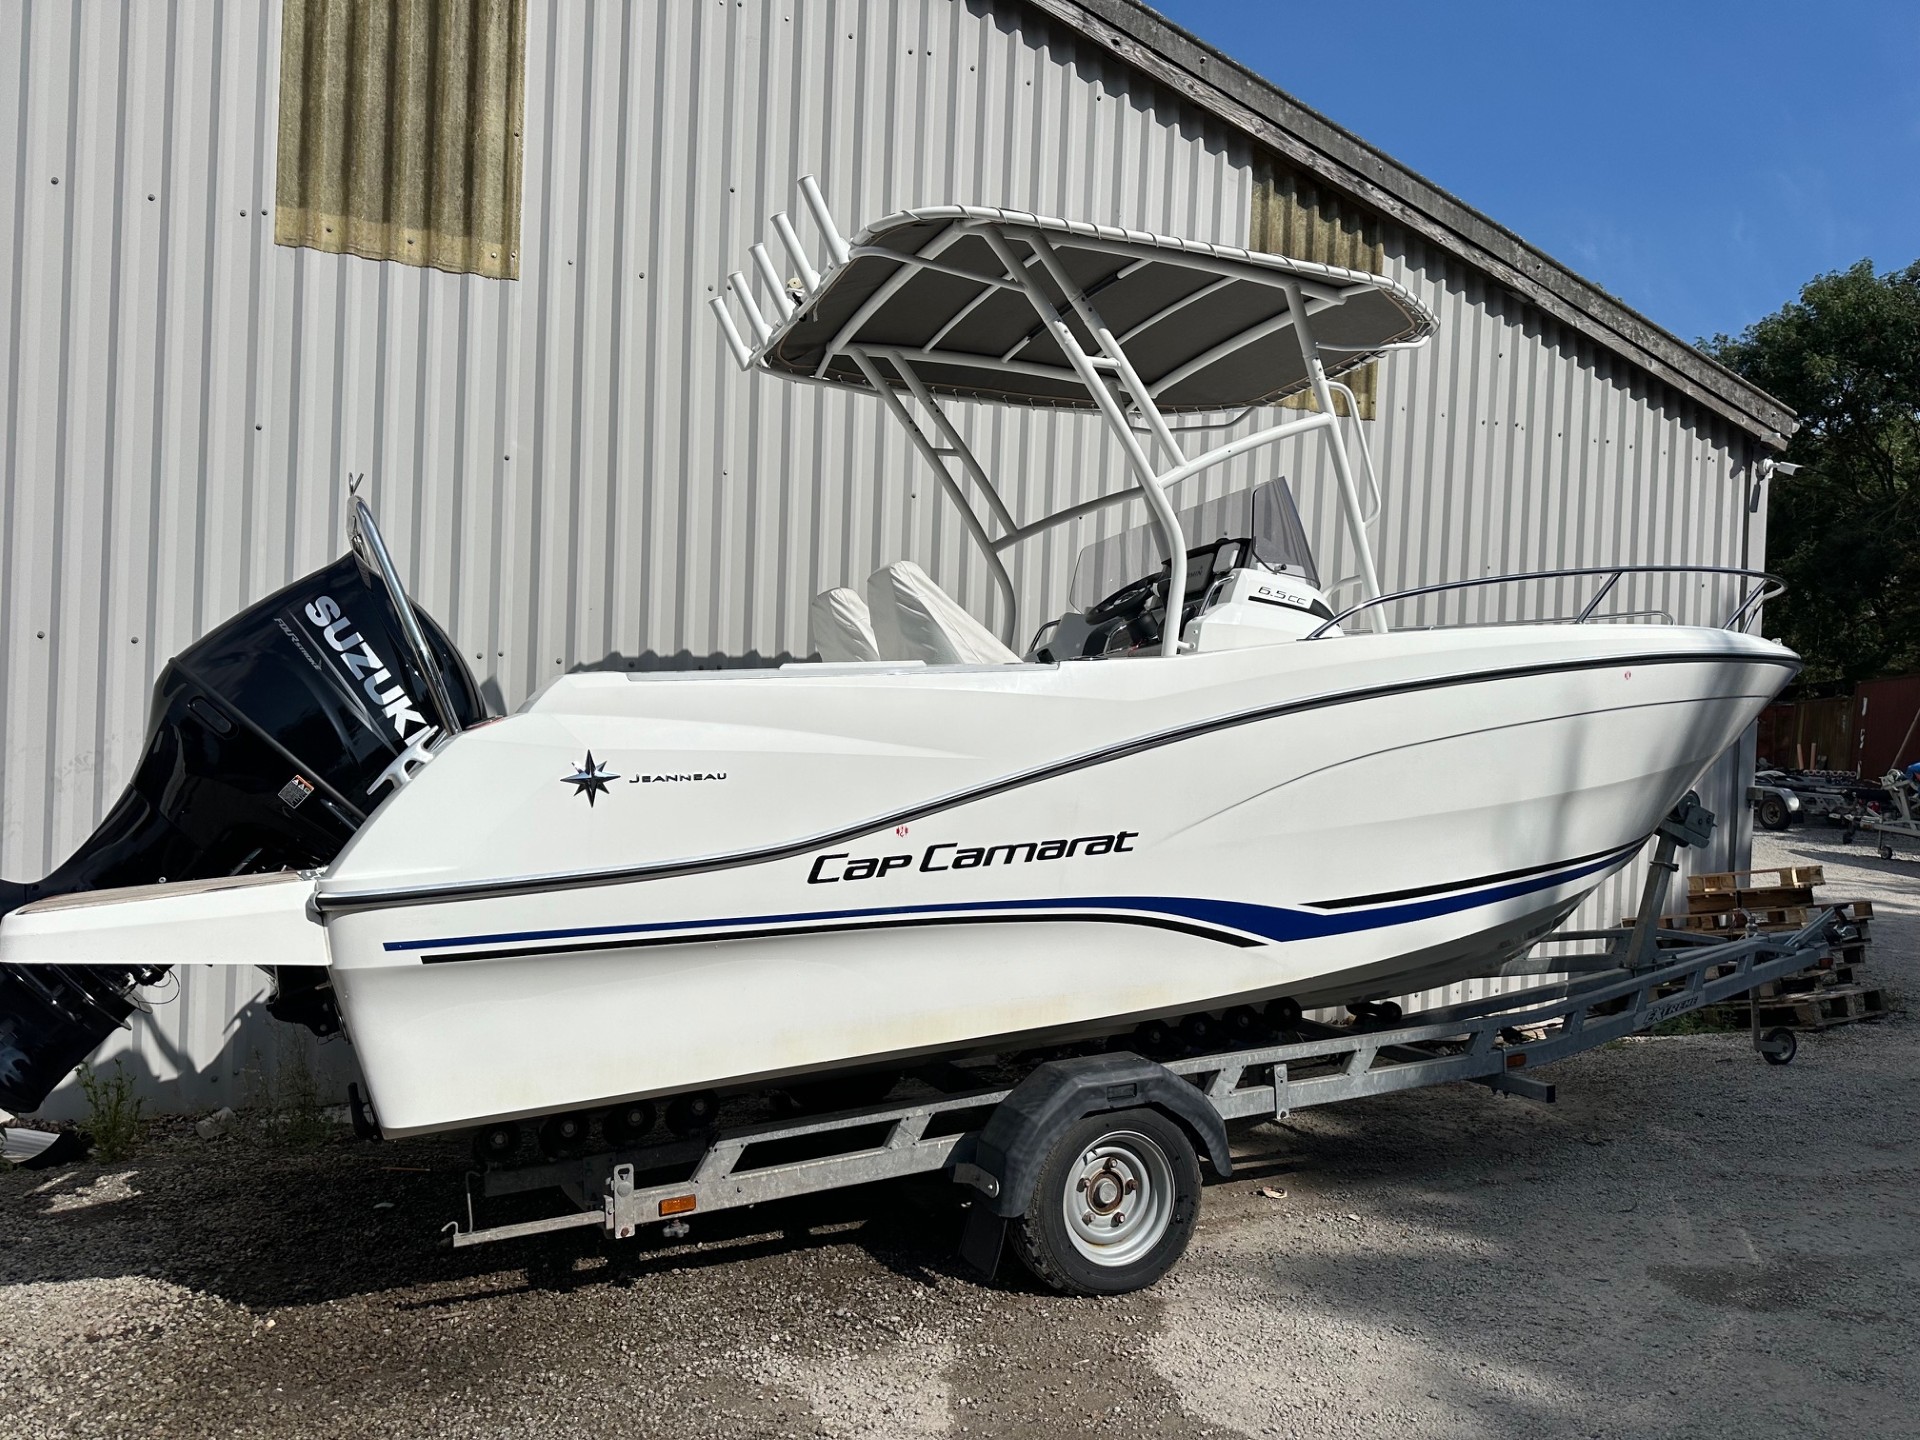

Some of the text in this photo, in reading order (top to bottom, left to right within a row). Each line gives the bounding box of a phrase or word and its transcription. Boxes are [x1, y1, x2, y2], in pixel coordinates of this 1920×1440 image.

[1258, 586, 1286, 599] 6.5
[304, 595, 431, 747] SUZUKI
[629, 773, 727, 784] JEANNEAU
[919, 830, 1139, 873] Camarat
